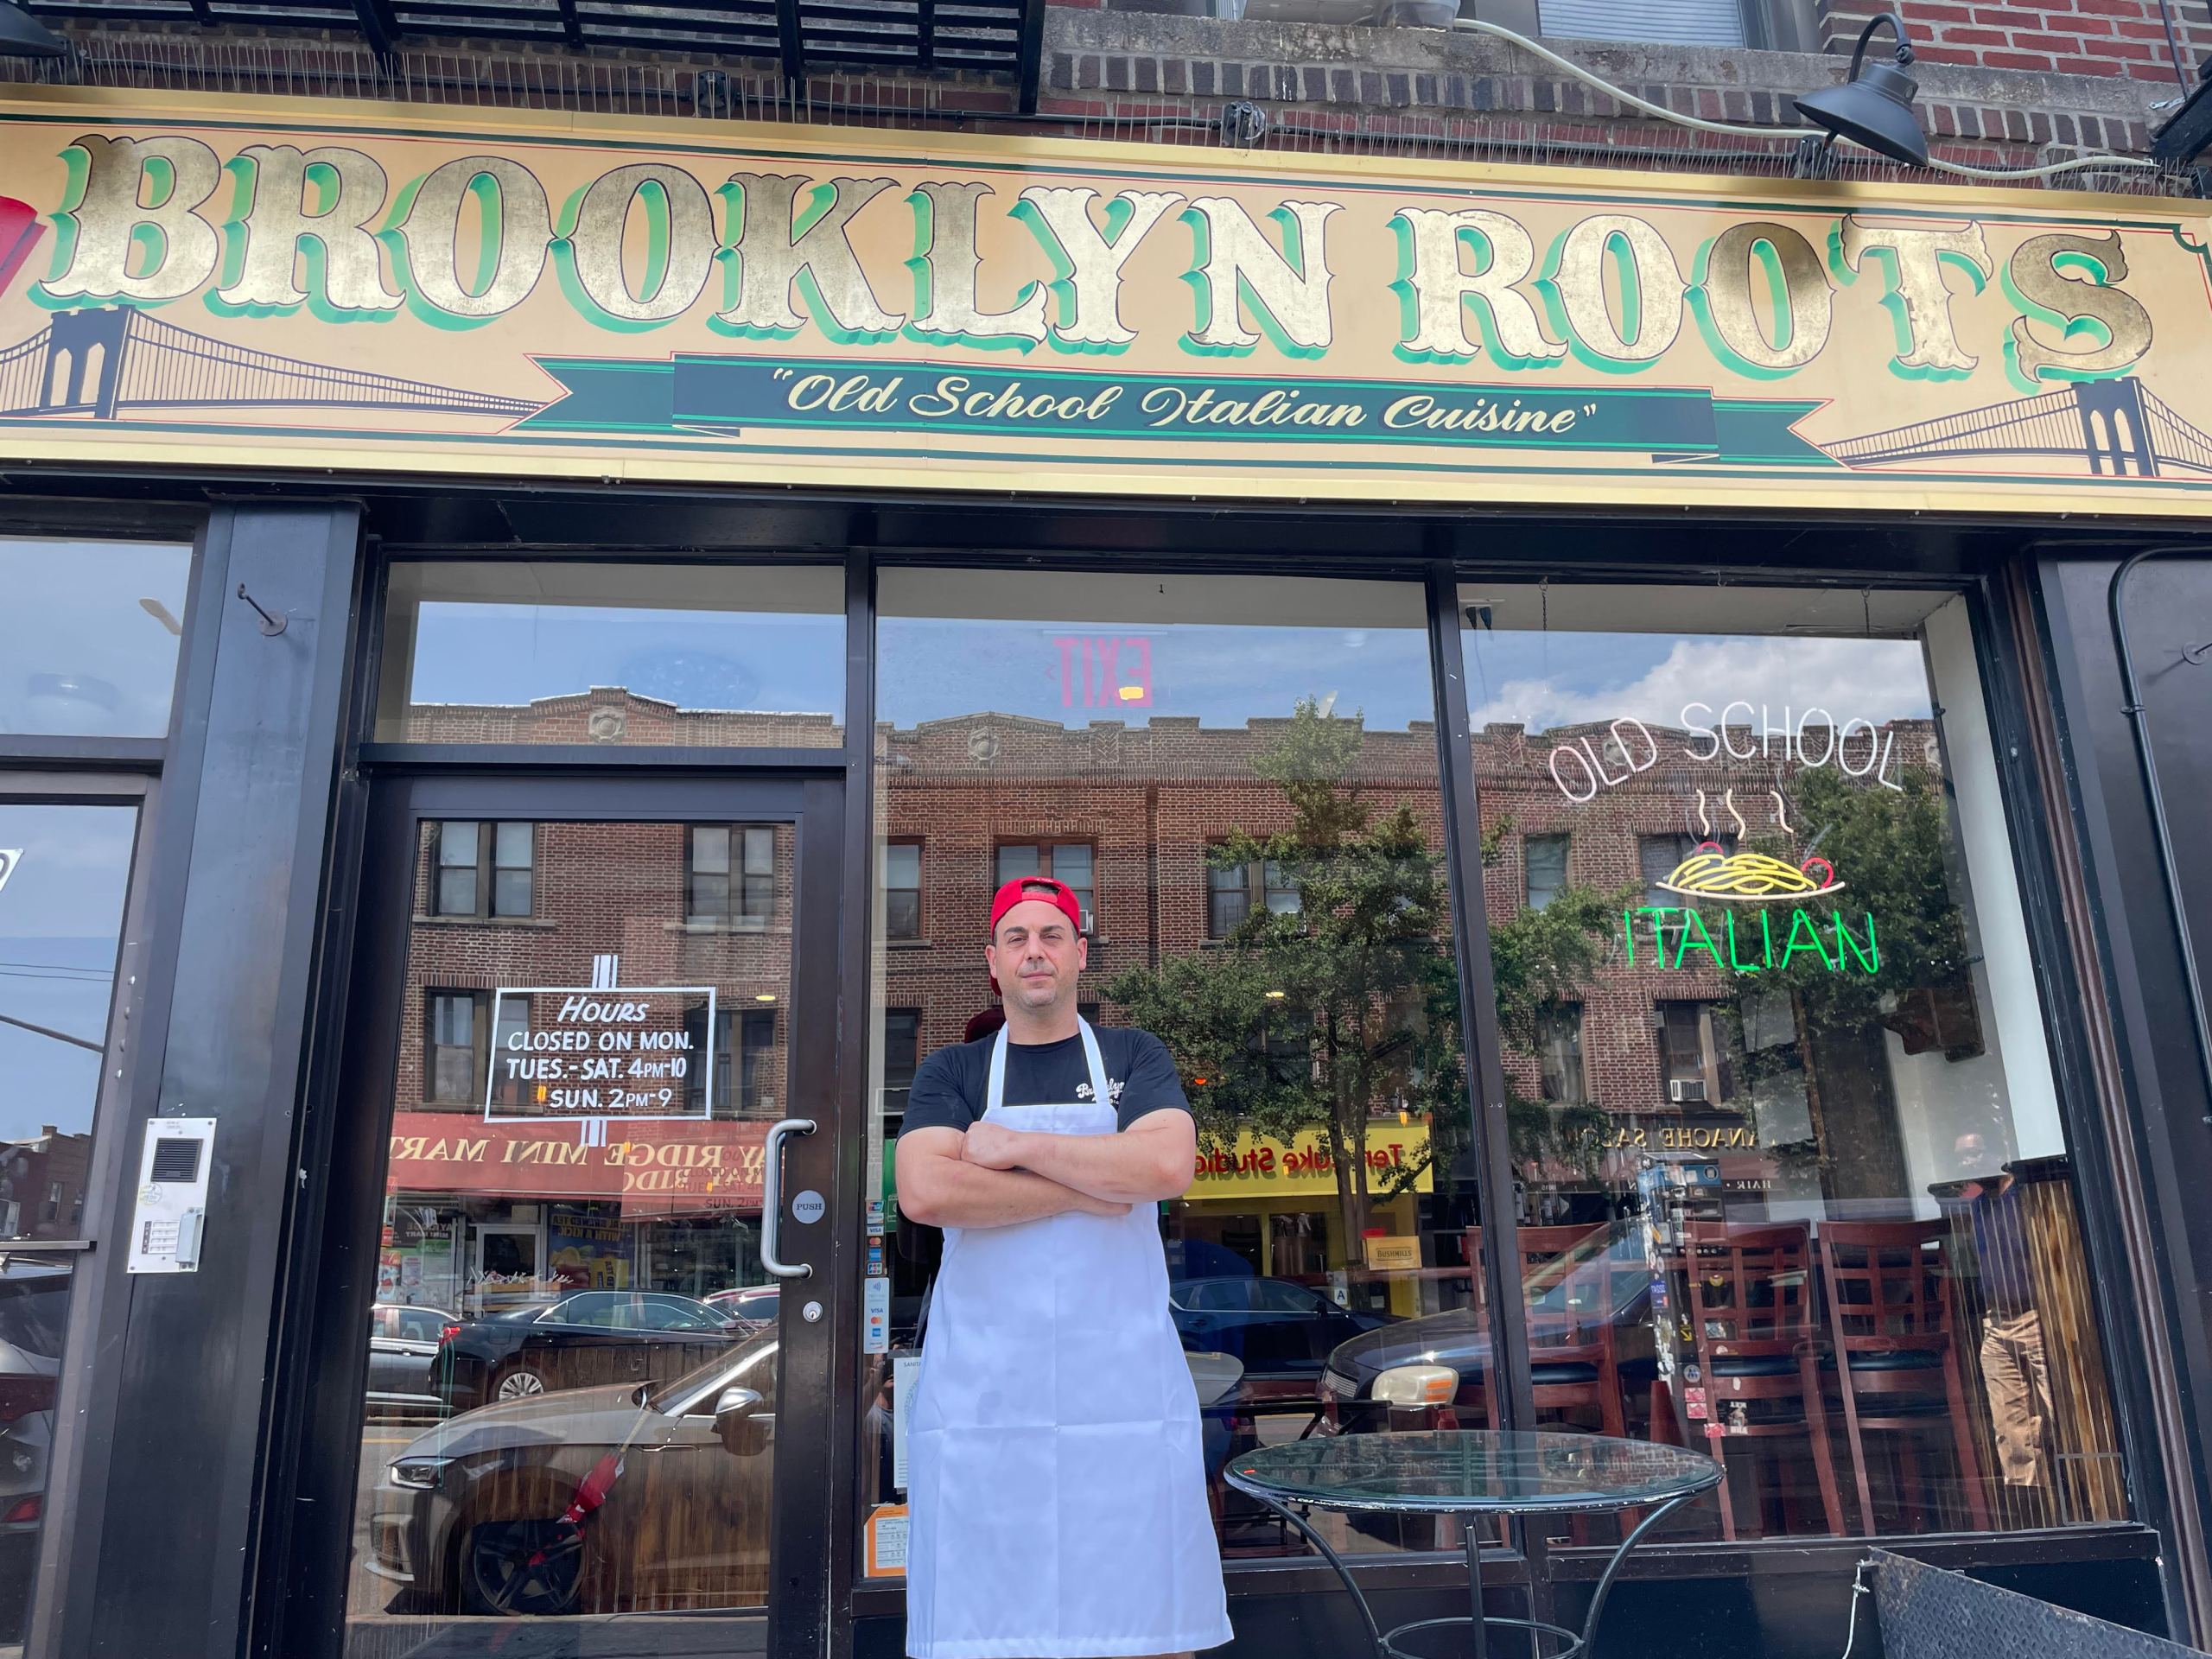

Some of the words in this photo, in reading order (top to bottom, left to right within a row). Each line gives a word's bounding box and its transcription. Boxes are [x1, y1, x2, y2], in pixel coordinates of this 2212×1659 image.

[29, 132, 1346, 358] BROOKLYN
[1389, 204, 2155, 385] ROOTS
[773, 367, 904, 413] "Old
[909, 375, 1124, 421] School
[1141, 386, 1367, 429] Italian
[1383, 394, 1598, 434] Cuisine"
[1548, 715, 1658, 804] OLD
[1680, 700, 1904, 792] SCHOOL
[1624, 906, 1880, 975] ITALIAN
[507, 1030, 590, 1052] CLOSED
[598, 1031, 627, 1052] ON
[639, 1030, 694, 1050] MON.
[550, 1088, 603, 1109] SUN.
[1376, 1249, 1413, 1259] BUSHMILLS
